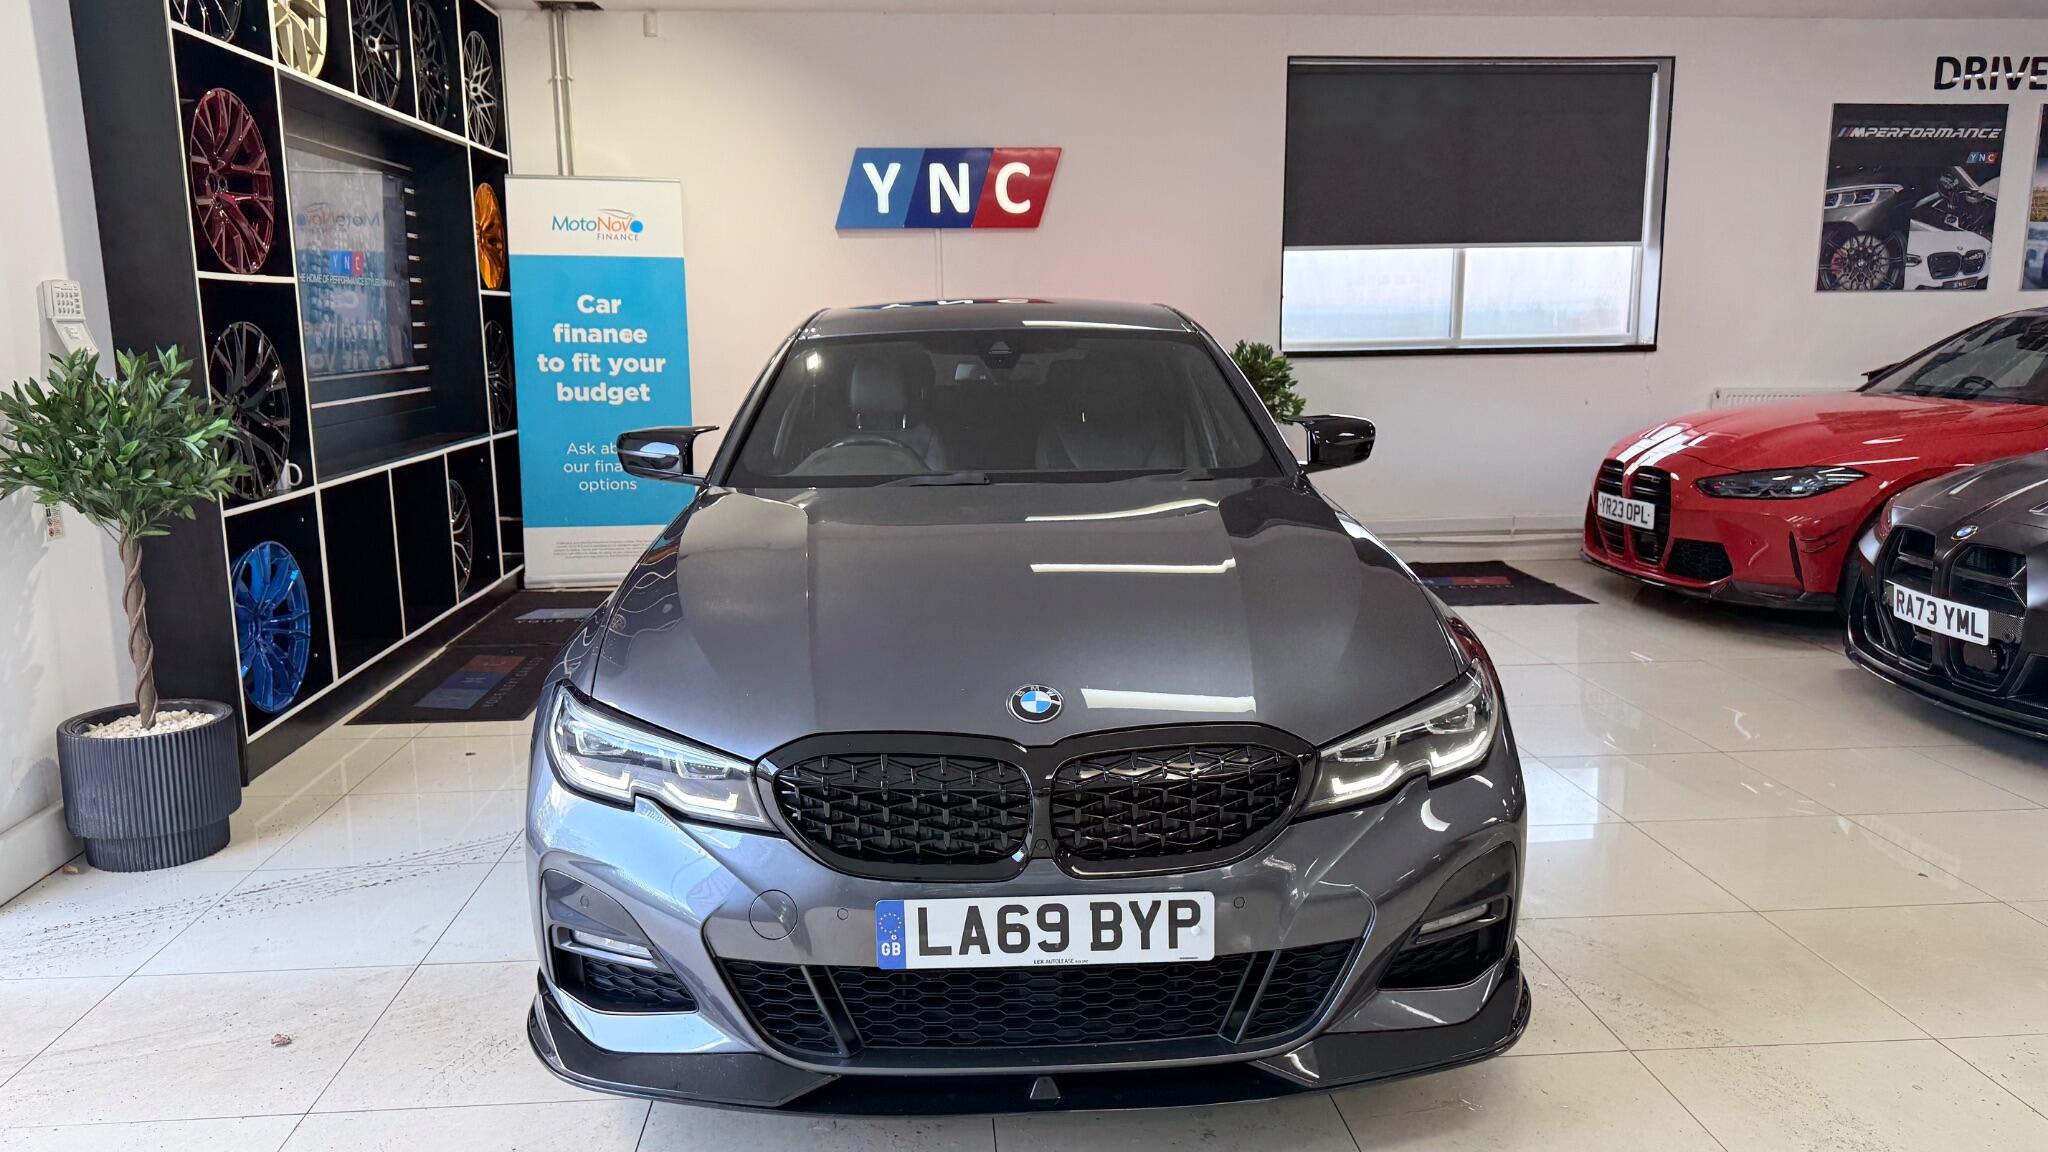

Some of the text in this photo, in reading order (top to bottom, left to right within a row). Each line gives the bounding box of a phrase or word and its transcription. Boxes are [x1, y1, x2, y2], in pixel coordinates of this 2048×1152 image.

[1934, 56, 2048, 90] DRIVE
[1970, 153, 1995, 162] YNC
[862, 161, 1032, 214] YNC
[552, 214, 644, 234] MotoNovo
[597, 233, 639, 241] FINANCE
[333, 255, 361, 271] YNC
[306, 273, 322, 283] HOME
[577, 294, 622, 314] Car
[552, 323, 648, 344] finance
[537, 353, 666, 376] to fit your
[556, 382, 651, 406] budget
[566, 442, 596, 455] Ask
[563, 461, 623, 473] our fina
[579, 478, 637, 493] options
[1601, 496, 1648, 524] YR23 OPL
[1896, 589, 1984, 639] RA73 YML
[917, 899, 1201, 956] LA69 BYP
[881, 942, 901, 957] GB
